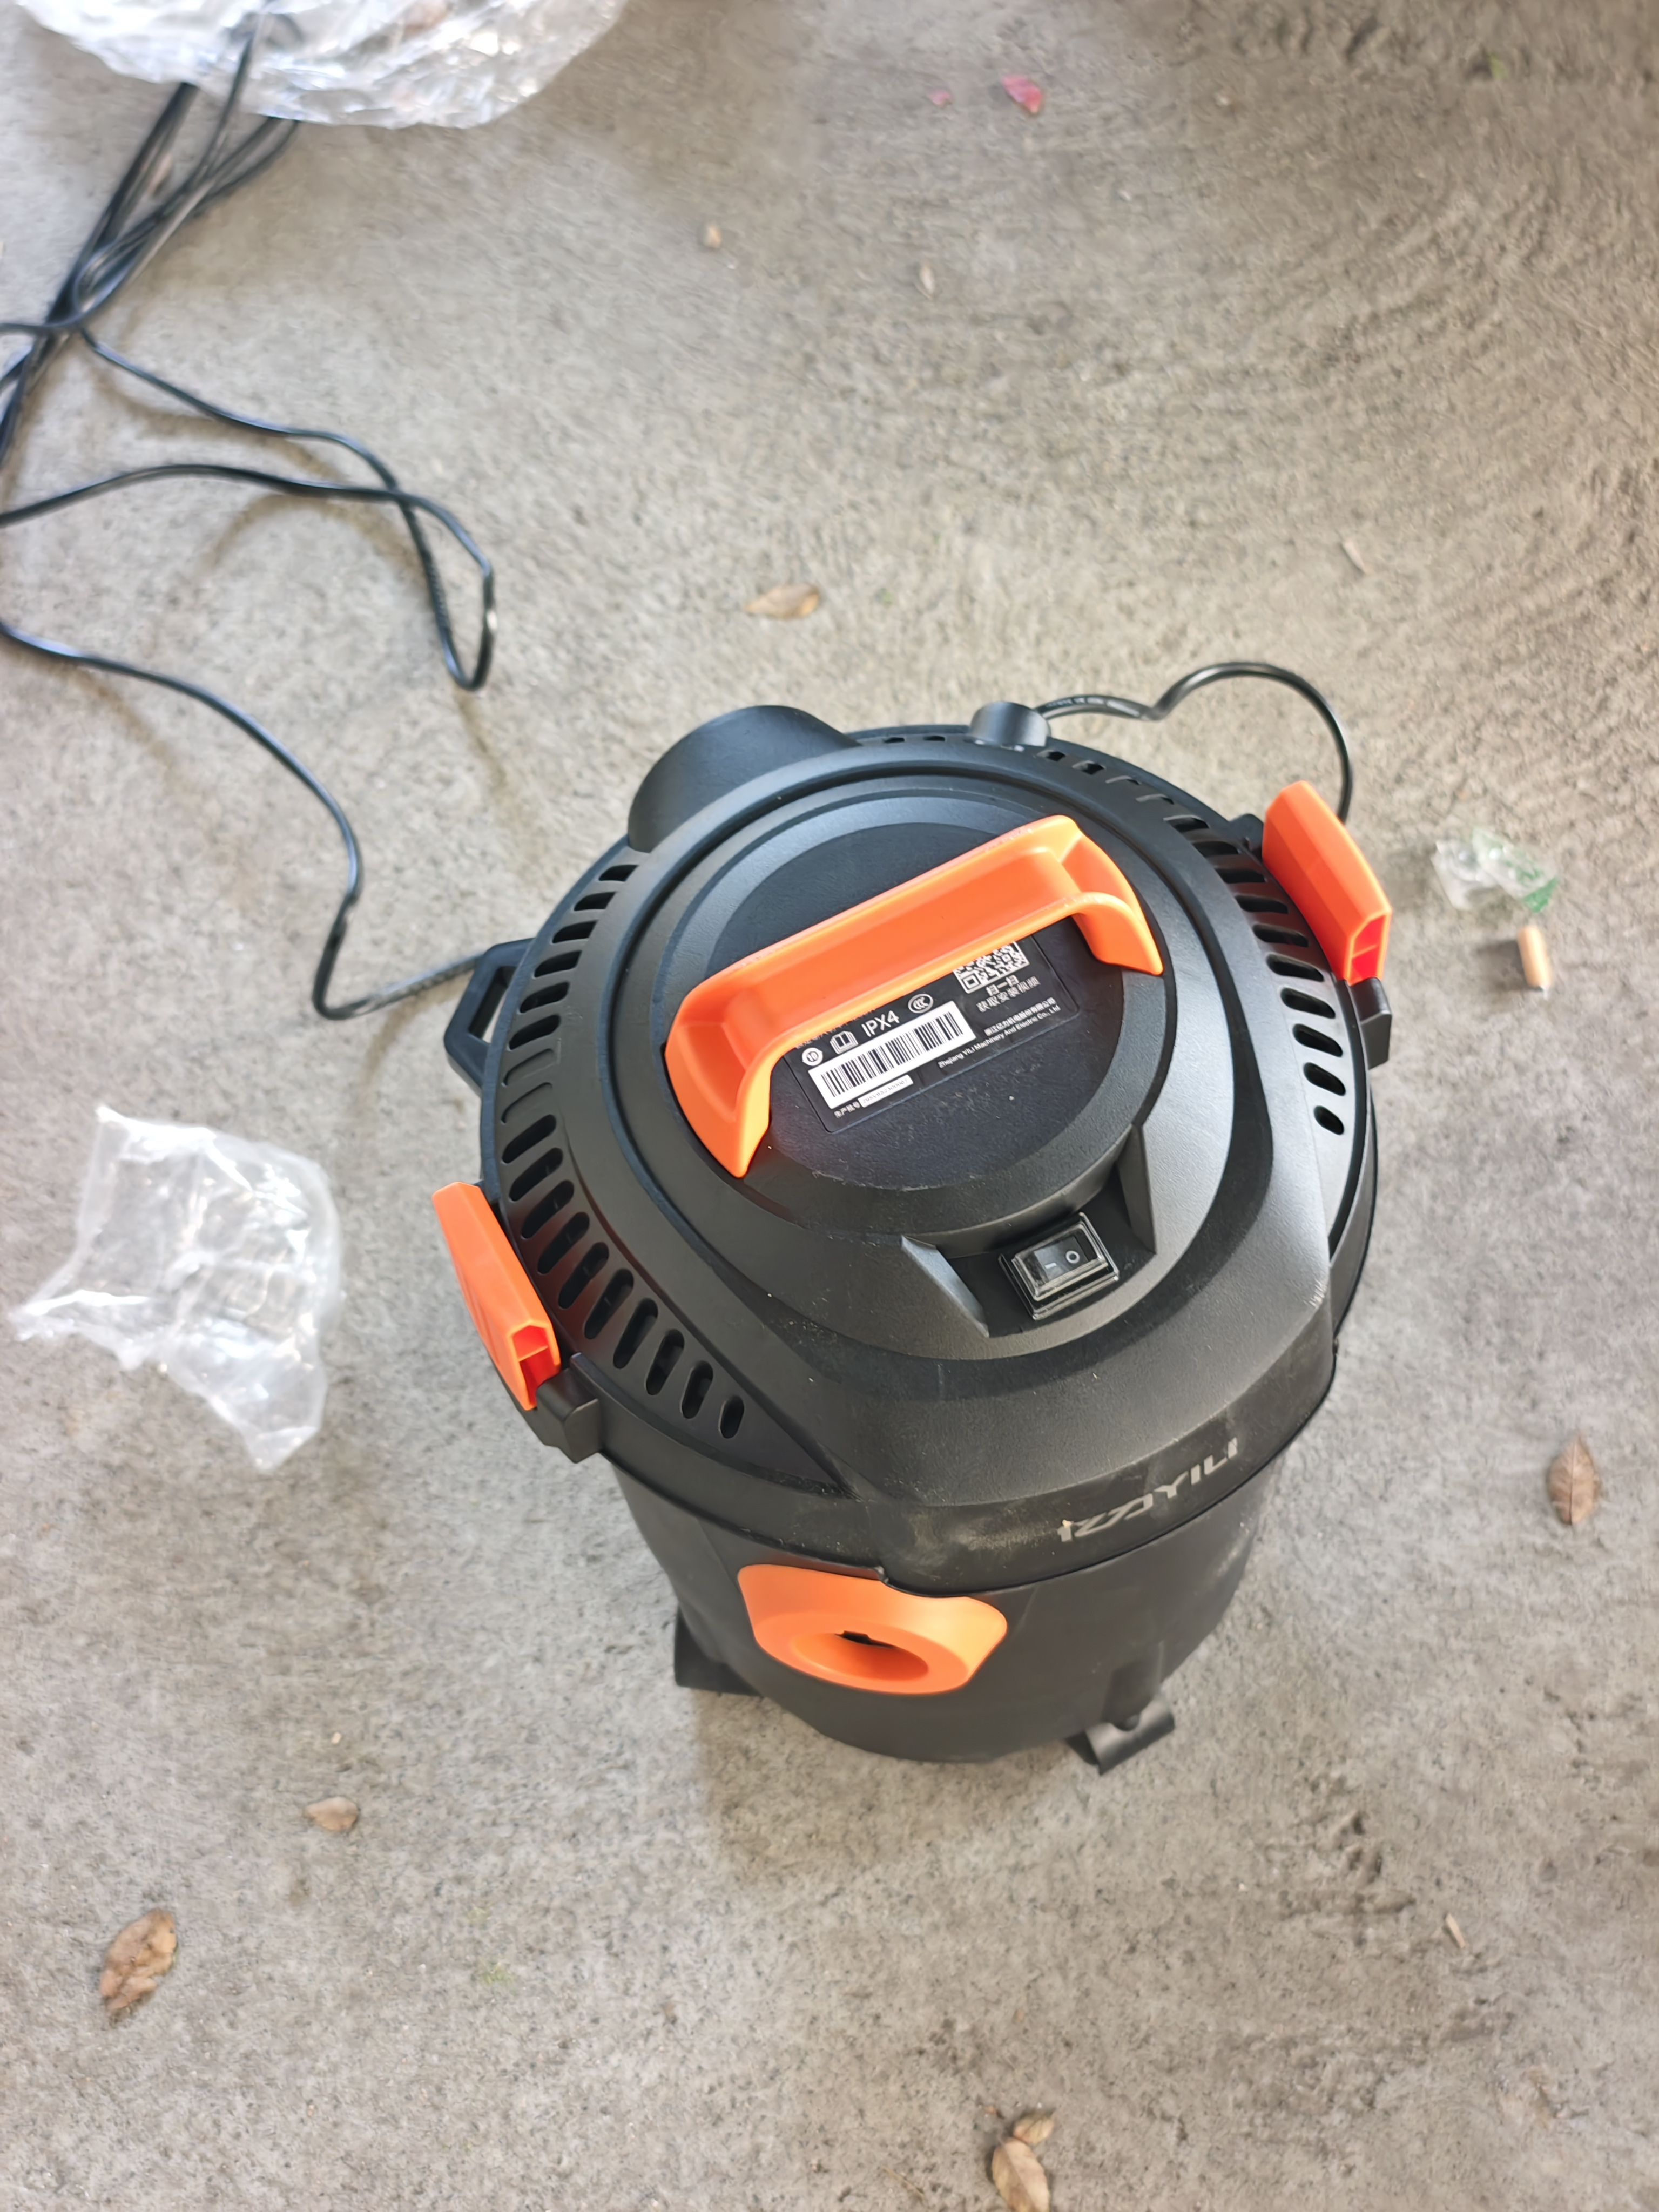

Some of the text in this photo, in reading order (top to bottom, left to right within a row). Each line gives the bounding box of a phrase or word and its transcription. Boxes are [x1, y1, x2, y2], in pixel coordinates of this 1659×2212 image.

[986, 975, 1019, 996] 扫一扫
[861, 1010, 900, 1037] IPX4
[938, 1053, 965, 1068] Zhejiang
[974, 1033, 1004, 1051] Machinery
[1004, 1026, 1017, 1036] And
[1154, 1437, 1238, 1499] YILI
